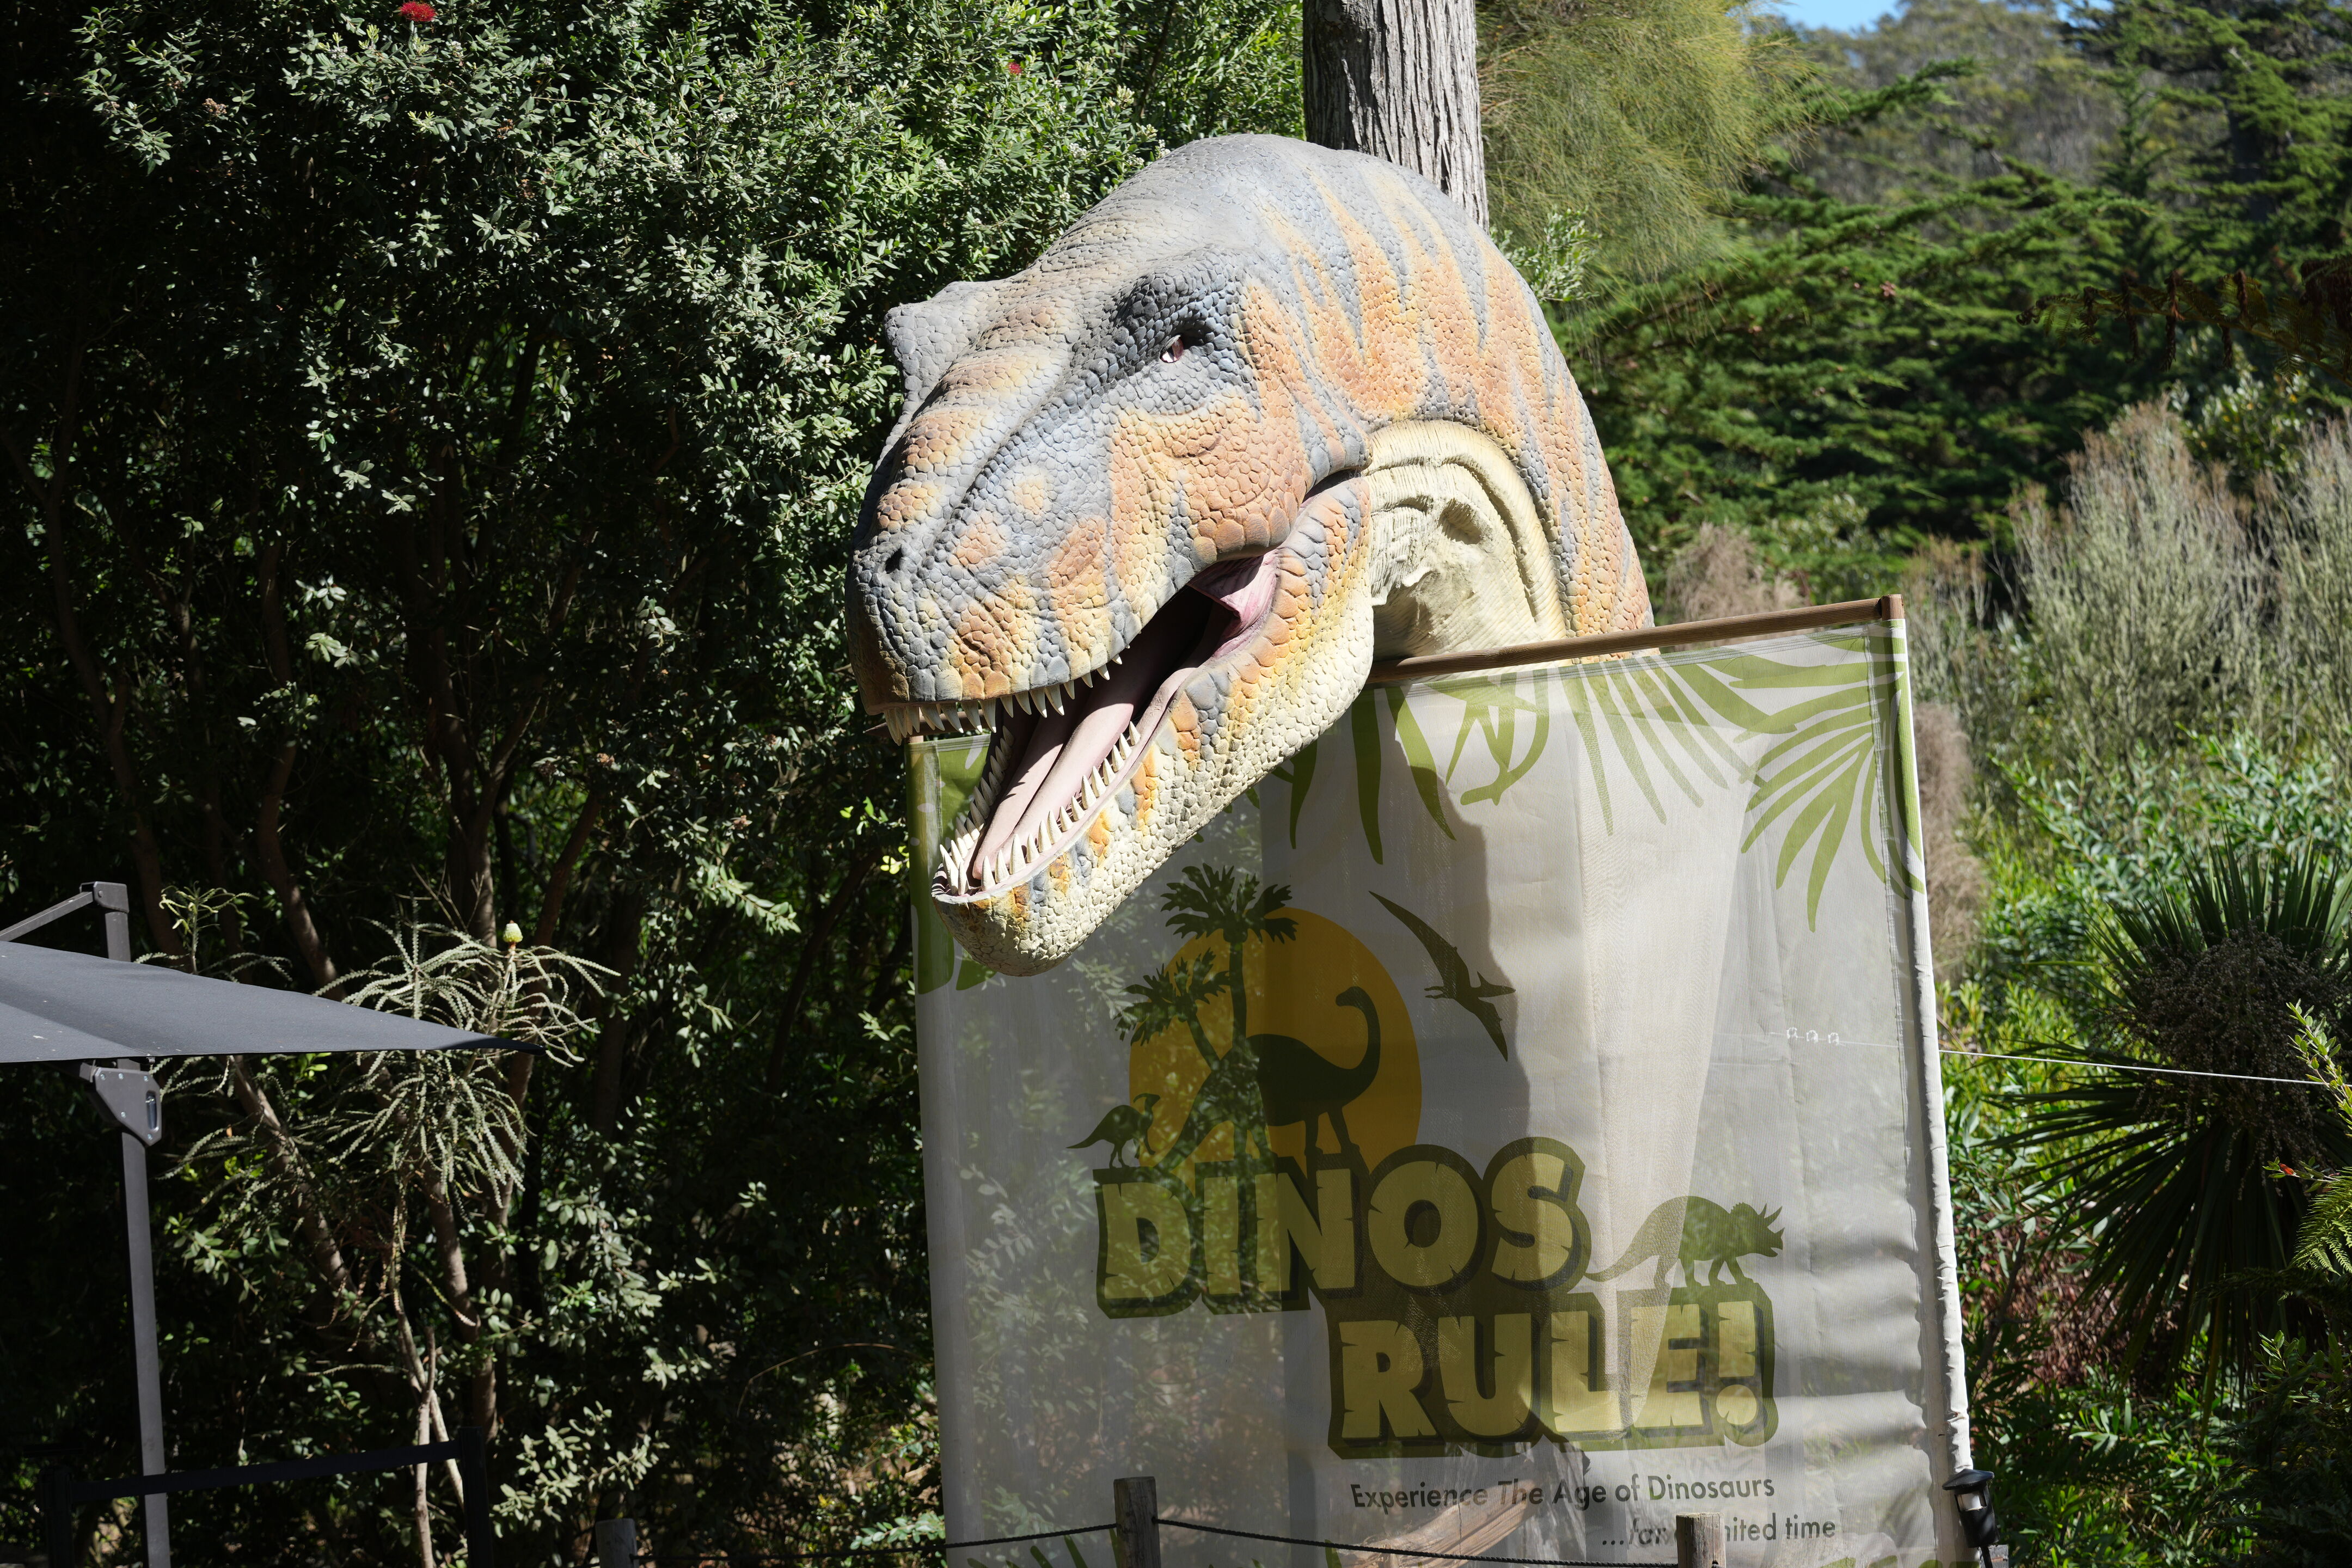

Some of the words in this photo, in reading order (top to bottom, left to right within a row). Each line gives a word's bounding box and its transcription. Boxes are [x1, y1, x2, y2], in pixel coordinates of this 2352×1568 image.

[1099, 1149, 1579, 1302] DINOS
[1337, 1299, 1759, 1441] RULE!
[1350, 1481, 1488, 1515] Experience
[1498, 1478, 1543, 1505] The
[1552, 1479, 1607, 1511] Age
[1614, 1474, 1640, 1502] of
[1647, 1474, 1775, 1500] Dinosaurs
[1725, 1512, 1777, 1542] ited
[1786, 1514, 1836, 1540] time
